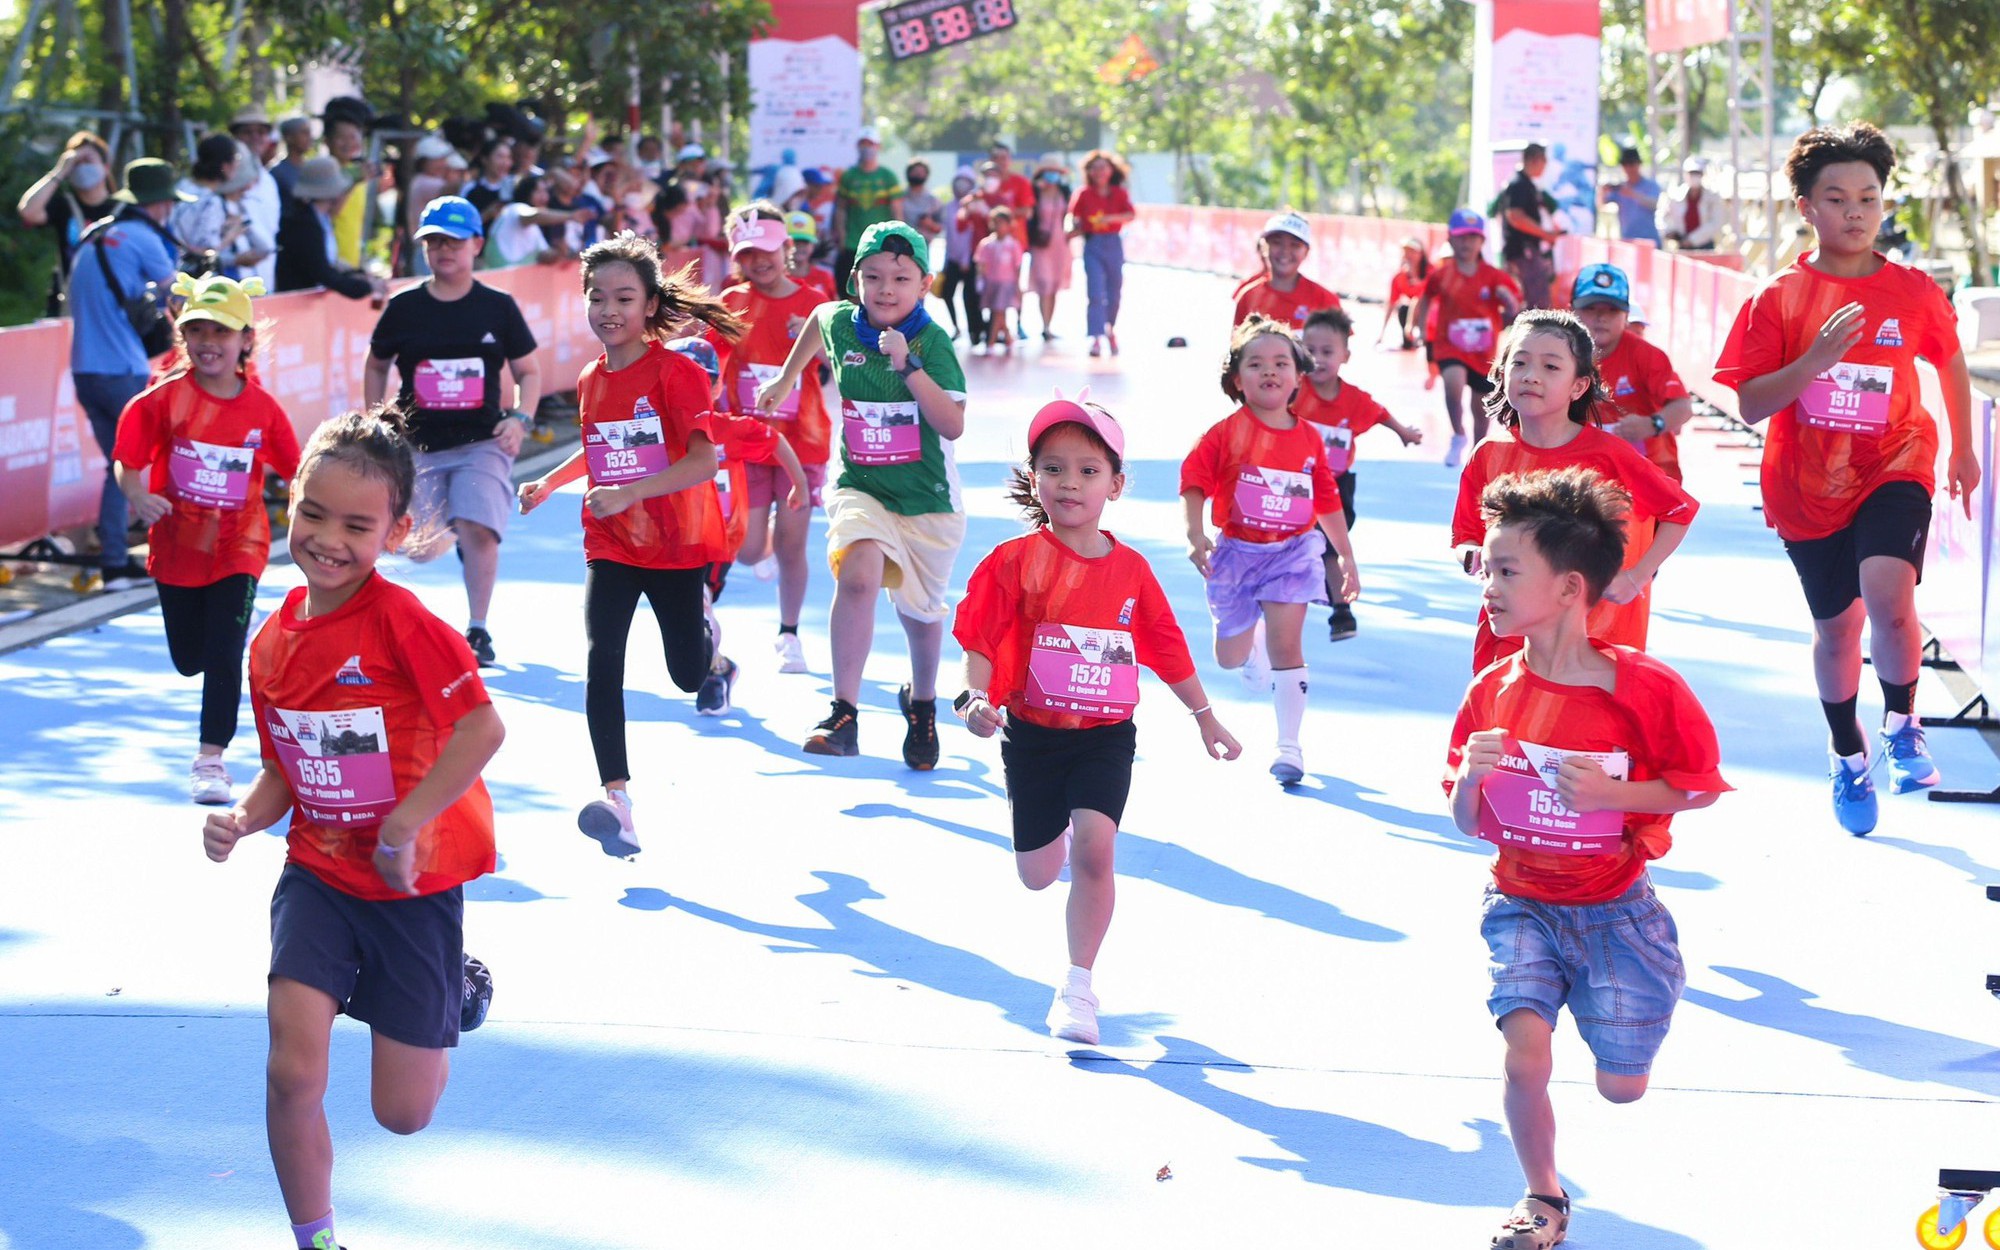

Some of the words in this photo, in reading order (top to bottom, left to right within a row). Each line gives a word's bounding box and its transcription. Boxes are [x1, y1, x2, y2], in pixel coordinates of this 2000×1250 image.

[1829, 390, 1861, 408] 1511
[861, 428, 892, 443] 1516
[604, 450, 638, 469] 1525
[194, 468, 228, 487] 1530
[1261, 495, 1292, 512] 1528
[1069, 663, 1112, 686] 1526
[297, 759, 342, 787] 1535
[353, 811, 376, 820] MEDAL
